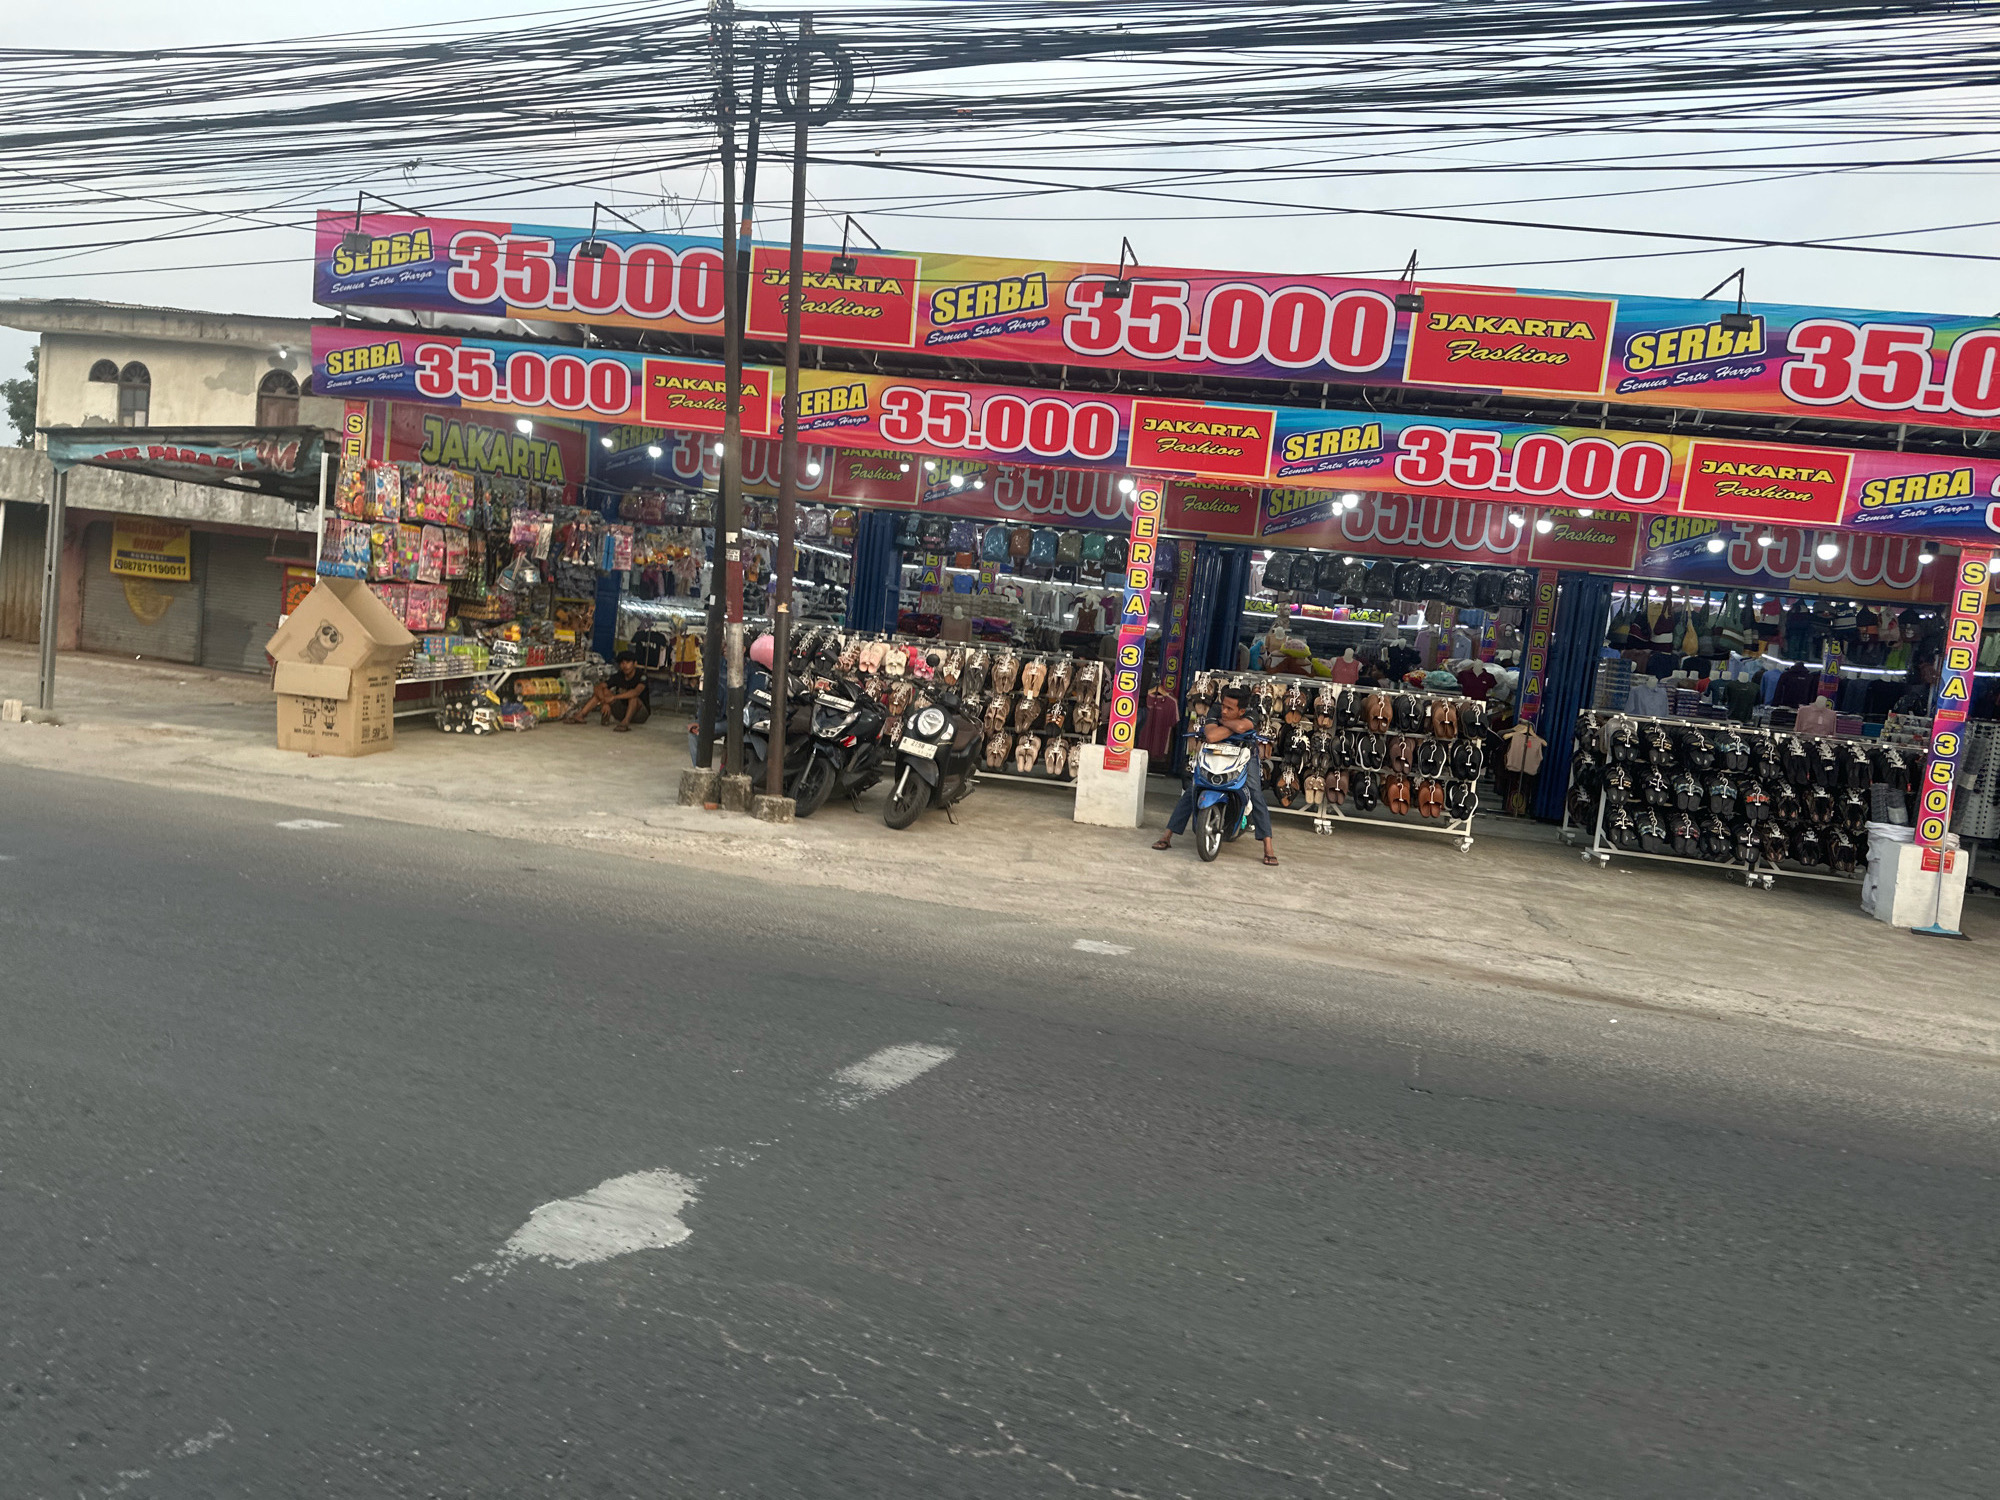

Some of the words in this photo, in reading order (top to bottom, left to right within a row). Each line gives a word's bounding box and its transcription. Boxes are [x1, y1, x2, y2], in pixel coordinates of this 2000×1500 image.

[331, 283, 365, 293] Semua
[369, 276, 394, 287] Satu
[399, 270, 432, 282] Harga
[448, 231, 726, 324] 35.000
[931, 273, 1048, 325] SERBA
[928, 331, 968, 344] Semua
[973, 325, 1002, 337] Satu
[1007, 319, 1046, 330] Harga
[1063, 275, 1396, 372] 35.000
[1427, 312, 1595, 341] JAKARTA
[326, 340, 404, 377] SERBA
[1446, 340, 1569, 365] Fashion
[1624, 315, 1766, 374] SERBA
[326, 380, 352, 389] Semua
[355, 375, 374, 384] Satu
[378, 371, 403, 380] Harga
[414, 343, 632, 415] 35.000
[1620, 379, 1668, 392] Semua
[1673, 372, 1709, 384] Satu
[1715, 365, 1762, 379] Harga
[1780, 318, 2000, 418] 35.0
[654, 375, 760, 397] JAKARA
[781, 382, 868, 419] ERBA
[813, 420, 835, 429] Satu
[839, 416, 867, 426] Harga
[879, 386, 1119, 460] 35.000
[1143, 418, 1261, 439] JAKARTA
[421, 414, 565, 485] JAKARTA
[1156, 437, 1243, 457] Fashion
[1282, 421, 1384, 463] SERBA
[850, 463, 902, 481] Fashion
[1280, 467, 1314, 477] Semua
[1319, 462, 1343, 471] Satu
[1348, 457, 1381, 467] Harga
[1395, 425, 1672, 504] 35.000
[1700, 460, 1835, 484] JAKARTA
[1714, 480, 1813, 502] Fashion
[1860, 467, 1975, 510] SERBA
[1182, 495, 1240, 514] Fashion
[1855, 513, 1894, 524] Semua
[1902, 508, 1927, 518] Satu
[1932, 504, 1970, 515] Harga
[1553, 524, 1617, 544] Fashion
[1123, 489, 1159, 618] SERBA
[1171, 549, 1190, 636] SERBA
[1350, 610, 1393, 623] KASI
[1941, 561, 1986, 700] SERBA
[1525, 583, 1553, 695] SERBA
[1165, 657, 1177, 689] 35
